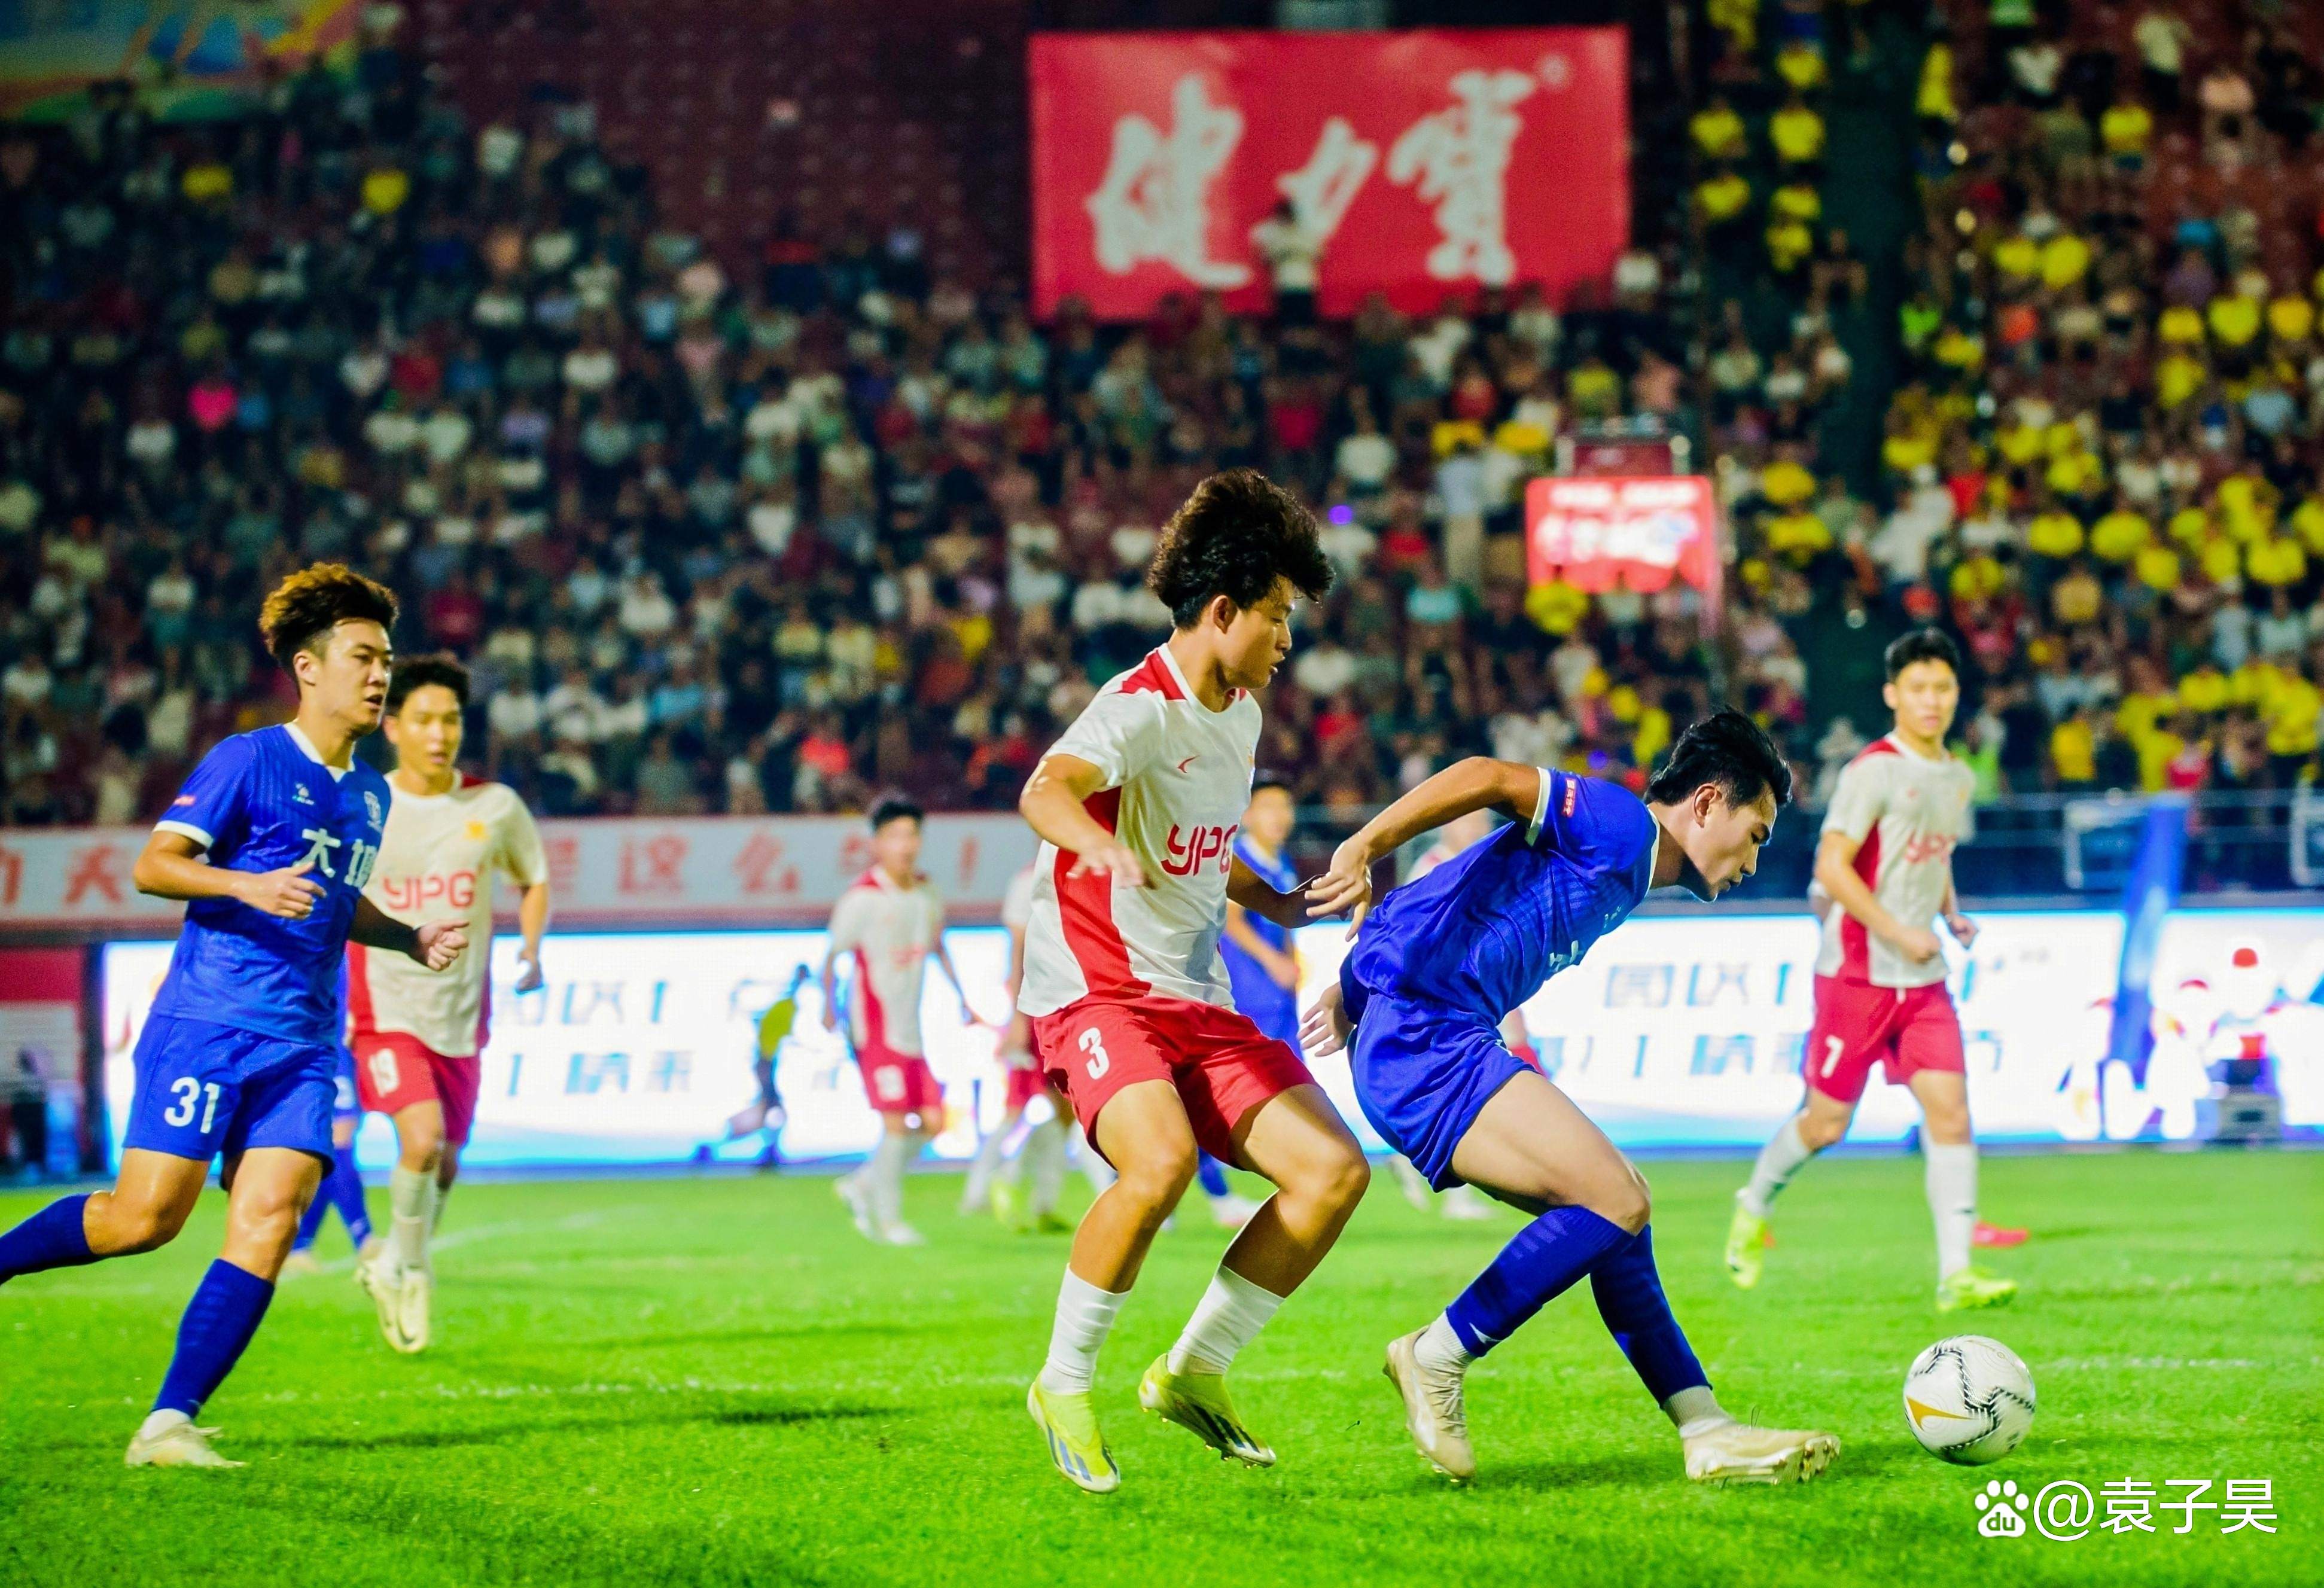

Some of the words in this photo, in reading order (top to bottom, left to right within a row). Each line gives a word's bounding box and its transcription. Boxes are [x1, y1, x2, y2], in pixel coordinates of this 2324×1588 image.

[383, 869, 477, 912] YPG
[1078, 1026, 1110, 1080] 3
[1820, 1035, 1845, 1078] 7
[164, 1076, 221, 1134] 31
